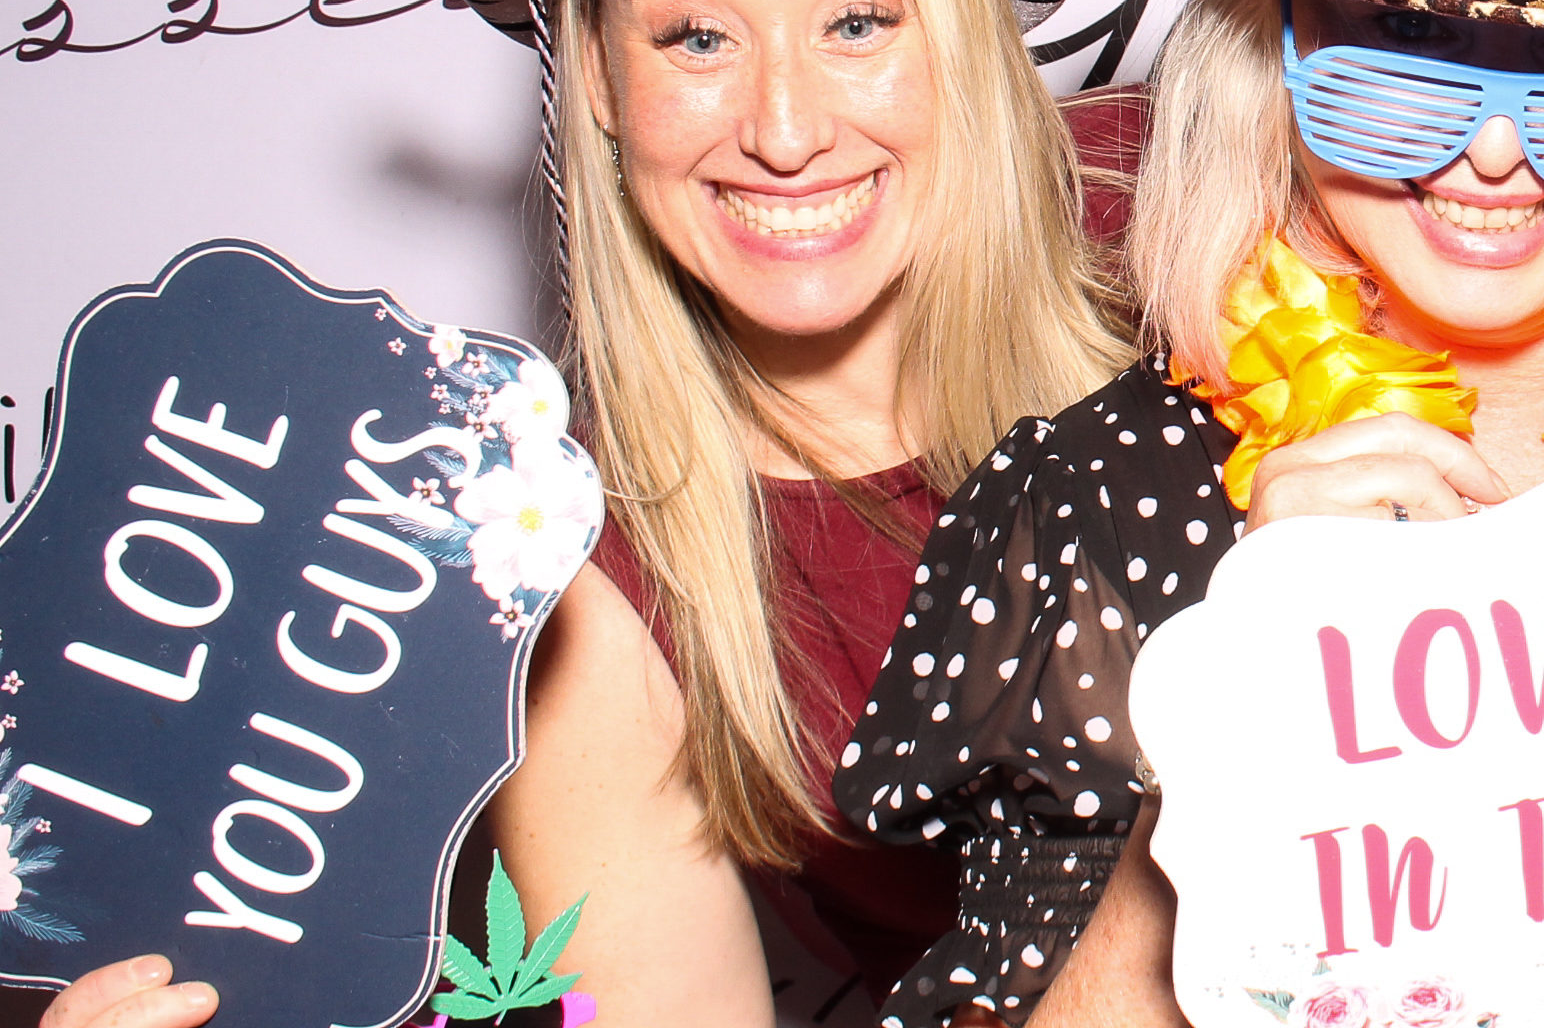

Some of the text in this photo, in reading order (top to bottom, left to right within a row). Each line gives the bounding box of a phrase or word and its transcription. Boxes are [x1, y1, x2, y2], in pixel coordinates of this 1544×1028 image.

[17, 375, 290, 826] I LOVE
[184, 408, 484, 943] YOU GUYS
